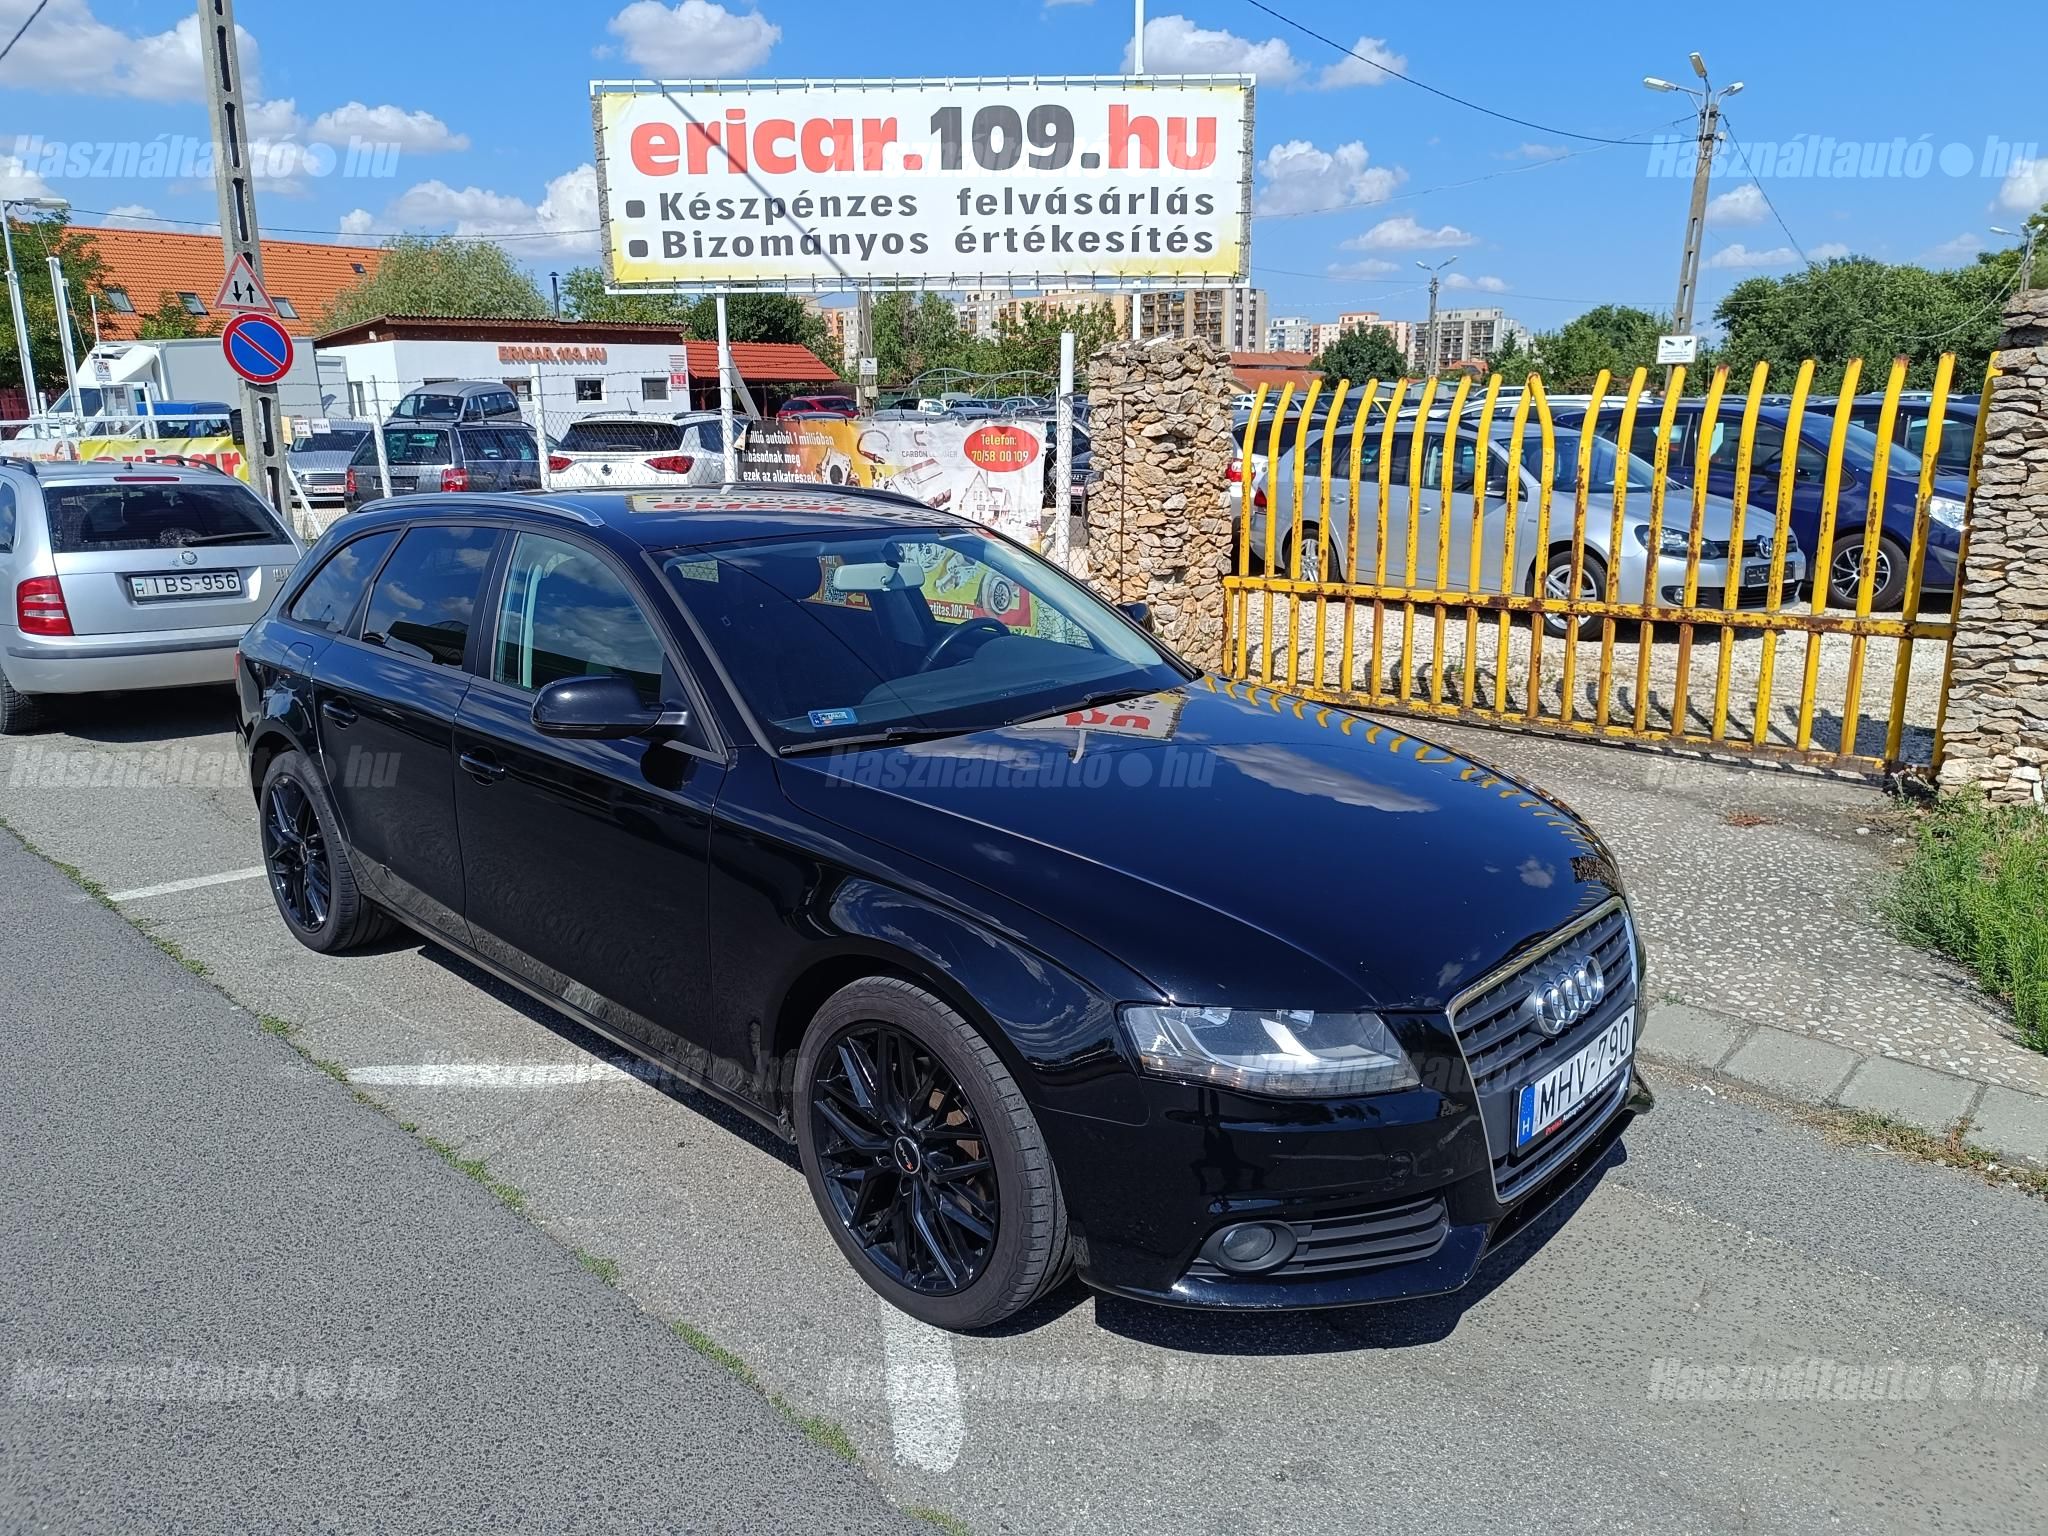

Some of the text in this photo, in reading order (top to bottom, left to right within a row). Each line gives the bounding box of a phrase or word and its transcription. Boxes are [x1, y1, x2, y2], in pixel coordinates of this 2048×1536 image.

[630, 104, 1216, 176] ericar.109.hu
[659, 187, 1214, 225] Készpénzes felvásárlás
[662, 225, 1213, 261] Bizományos értékesítés
[499, 346, 607, 363] ERICAR.109.HU
[765, 430, 793, 445] autóból
[799, 432, 834, 446] millióban
[981, 434, 1017, 446] Telefon:
[784, 453, 801, 467] meg
[971, 450, 1029, 463] 70/58 00 109
[743, 469, 762, 482] ezek
[762, 473, 772, 482] az
[153, 574, 237, 594] IBS-956
[1538, 1015, 1630, 1125] MHV-790
[1521, 1117, 1531, 1136] H
